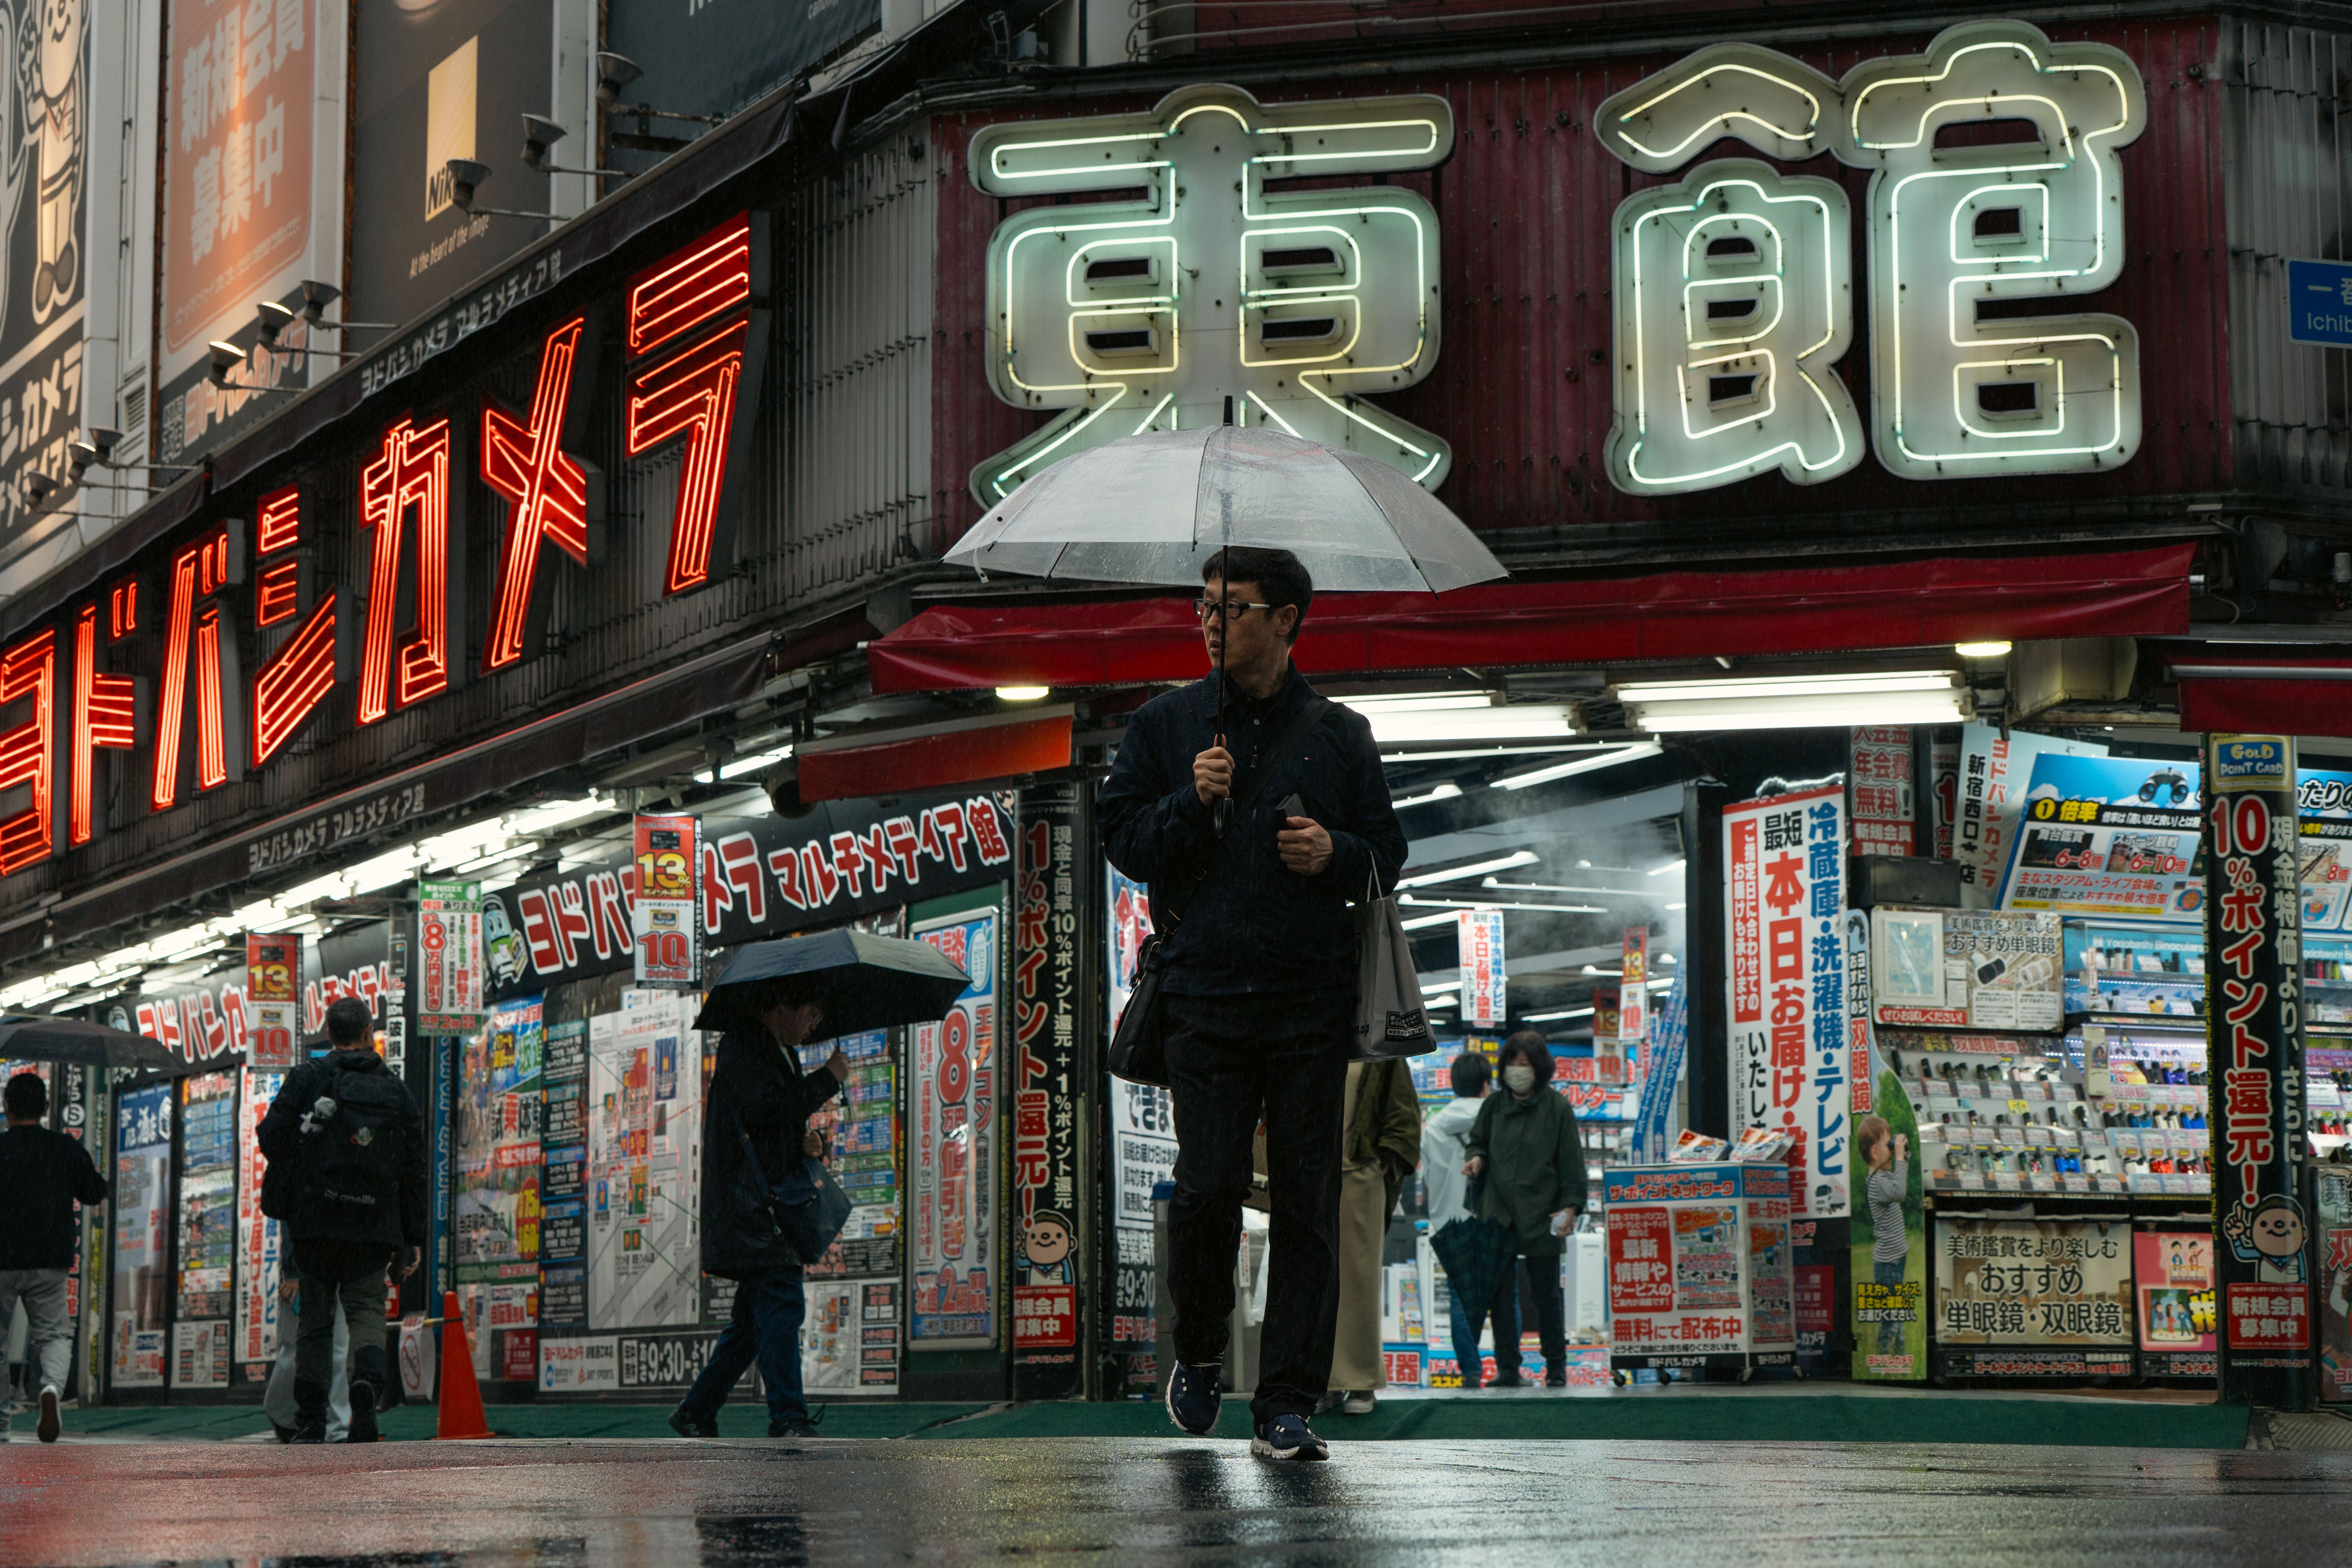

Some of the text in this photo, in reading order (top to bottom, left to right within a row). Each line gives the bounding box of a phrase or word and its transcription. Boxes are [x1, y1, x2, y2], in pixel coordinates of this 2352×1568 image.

[191, 93, 285, 266] 募集中
[410, 257, 418, 279] At
[419, 249, 429, 273] the
[430, 238, 448, 265] heart
[448, 232, 456, 254] of
[457, 222, 467, 247] the
[361, 249, 561, 398] ヨドバシカメラ マルチメディア館
[0, 218, 750, 877] ヨドバシカメラ
[2230, 743, 2274, 760] GOLD
[1853, 750, 1910, 782] 年会費
[2220, 760, 2284, 777] POINT CARD
[1855, 785, 1910, 817] 無料!
[1981, 738, 2010, 888] ヨドバシカメラ
[2059, 800, 2099, 822] 倍率
[249, 783, 425, 872] ヨドバシカメラ マルチメディア館
[1765, 810, 1803, 852] 最短
[1855, 823, 1912, 842] 新規会員
[2038, 828, 2085, 842] 舞台鑑賞
[2114, 833, 2180, 849] スポーツ観戦
[768, 796, 1010, 911] マルチメディア館
[637, 852, 692, 889] 13%
[2019, 871, 2163, 891] 主なスタジアム・ライブ会場の
[2326, 862, 2351, 883] 8倍
[422, 901, 480, 911] 相談承ります
[2014, 887, 2169, 905] 座席位置によるおすすめ最大倍率
[1733, 863, 1746, 1012] お届けも承ります
[1948, 918, 2056, 934] 美術鑑賞をより楽しむ
[639, 931, 692, 971] 10%
[1950, 935, 2057, 955] おすすめ単眼鏡
[249, 964, 294, 993] 13%
[1474, 925, 1490, 1019] 本日お届け・設置
[1857, 951, 1868, 1017] ヨドバシ
[1809, 800, 1844, 1176] 冷蔵庫・洗濯機・テレビ
[2210, 794, 2273, 1209] 10%ポイント還元!
[2272, 816, 2303, 1196] 現金特価より、さらに!
[1882, 1009, 1964, 1023] ぜひお試しください!
[249, 1027, 293, 1057] 10%
[1952, 1034, 2020, 1053] 双眼鏡売場
[1851, 1019, 1873, 1115] 双眼鏡
[1609, 1181, 1734, 1201] ザ・ポイントネットワーク
[1622, 1239, 1658, 1259] 最新
[1946, 1235, 2119, 1259] 美術鑑賞をより楽しむ
[1614, 1261, 1668, 1282] 情報や
[1981, 1264, 2084, 1295] おすすめ
[1125, 1270, 1155, 1308] 9:30
[1612, 1283, 1672, 1297] サービスの
[1857, 1282, 1922, 1296] 見え方や、サイズ、
[1857, 1296, 1916, 1309] 重さなど確認して
[2231, 1295, 2306, 1316] 新規会員
[1857, 1309, 1918, 1322] お選びください。
[1946, 1301, 2122, 1335] 単眼鏡・双眼鏡
[1613, 1316, 1742, 1342] 無料にて配布中
[2239, 1318, 2298, 1338] 募集中
[648, 1340, 685, 1382] 9:30
[1648, 1357, 1707, 1367] ヨドバシカメラ
[1866, 1354, 1914, 1367] ヨドバシカメラ
[1974, 1361, 2086, 1375] ゴールドポイントカード・プラス
